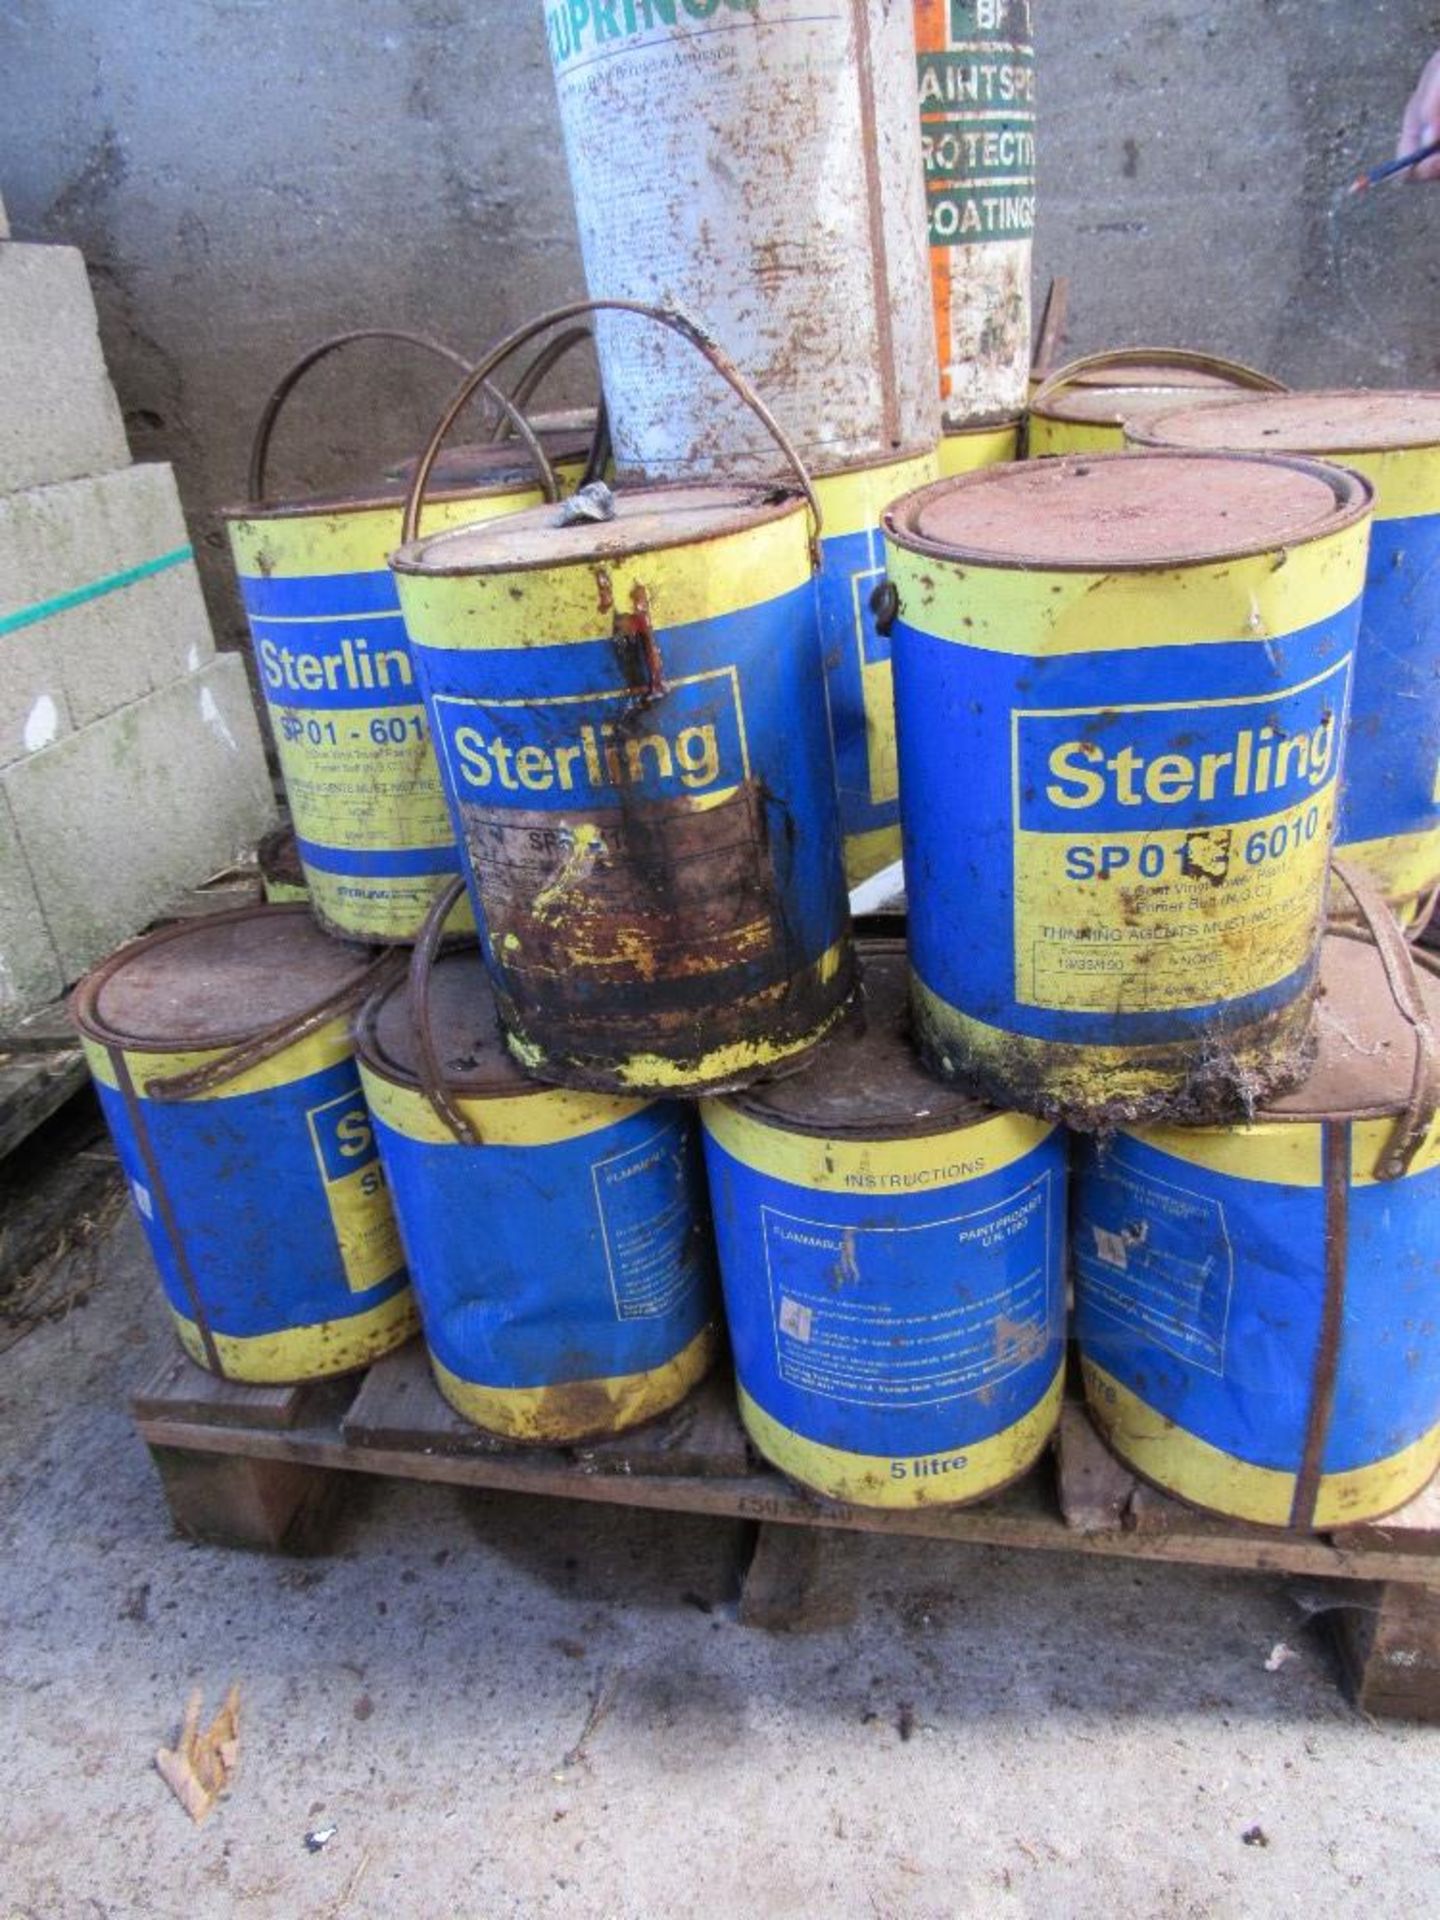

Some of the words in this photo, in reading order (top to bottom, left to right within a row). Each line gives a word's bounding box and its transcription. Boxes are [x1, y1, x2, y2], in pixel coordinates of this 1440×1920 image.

[454, 724, 719, 791] Sterling
[1046, 713, 1336, 810] Sterling
[1245, 806, 1319, 866] 6010
[845, 1156, 986, 1188] INSTRUCTIONS
[890, 1461, 907, 1480] 5
[914, 1453, 968, 1478] litre
